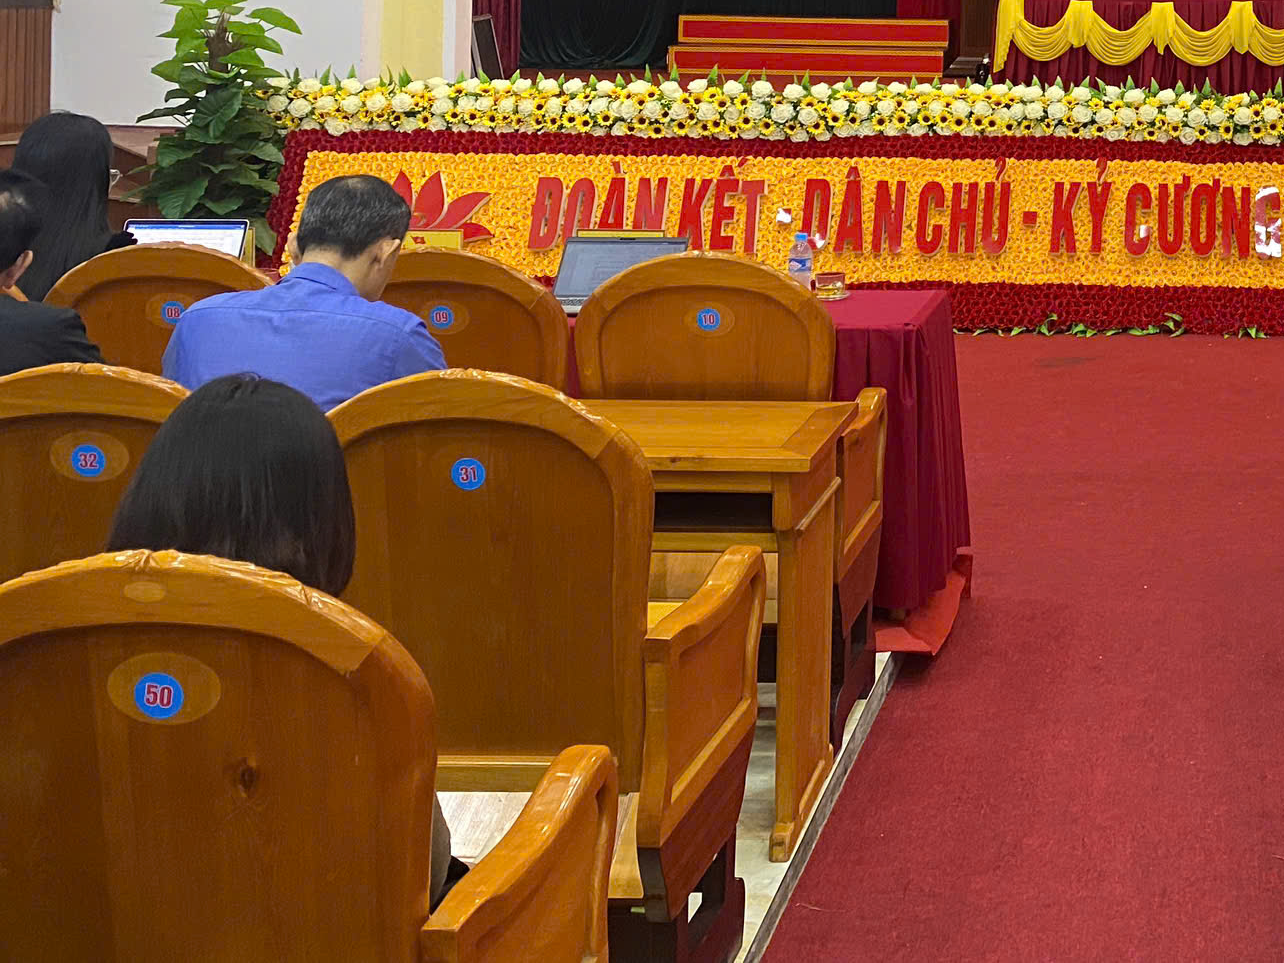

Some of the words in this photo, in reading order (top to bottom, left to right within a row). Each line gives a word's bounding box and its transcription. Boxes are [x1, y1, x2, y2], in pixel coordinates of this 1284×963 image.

[678, 156, 766, 254] KẾT
[801, 166, 907, 254] DÂN
[916, 156, 1011, 255] CHỦ
[1049, 157, 1114, 254] KỶ
[1124, 174, 1284, 259] CƯƠNG
[166, 306, 181, 319] 08
[434, 311, 449, 324] 09
[702, 313, 716, 326] 10
[78, 452, 99, 470] 32
[458, 465, 478, 483] 31
[143, 683, 173, 708] 50
